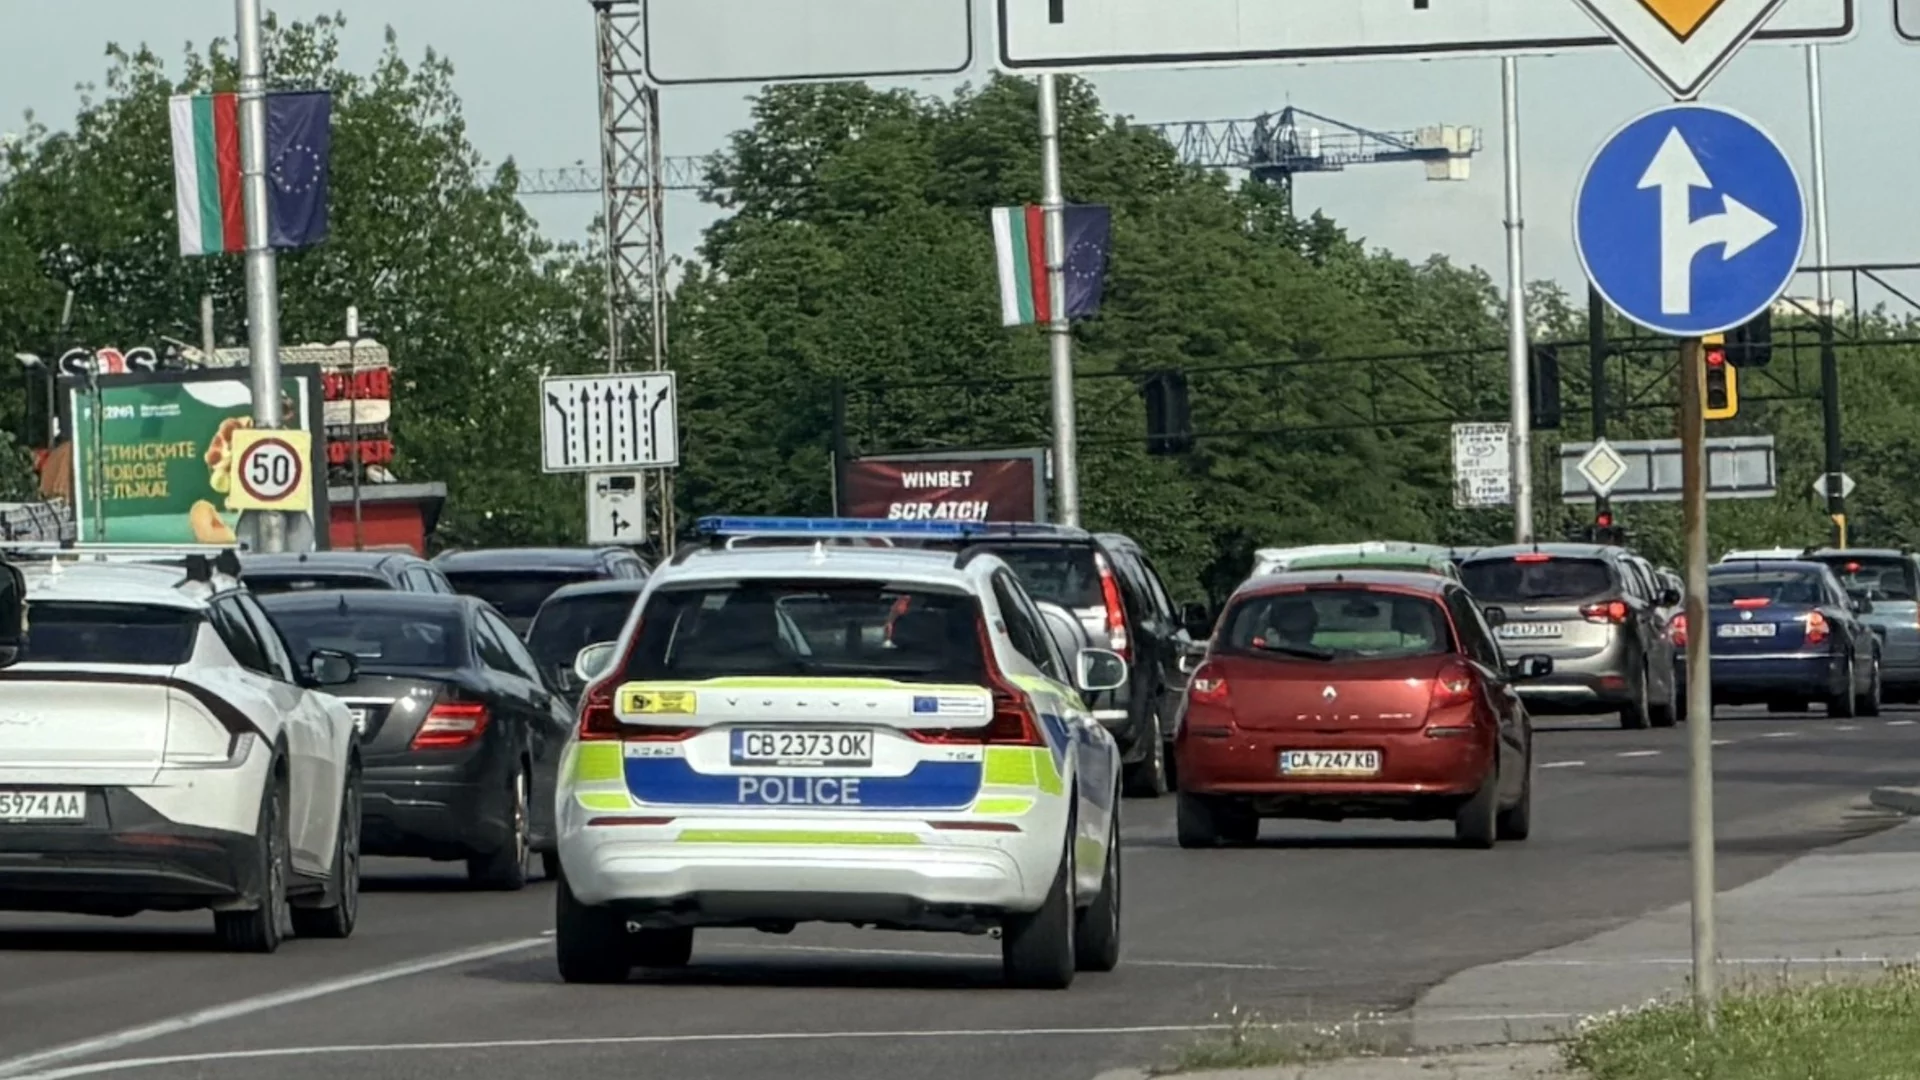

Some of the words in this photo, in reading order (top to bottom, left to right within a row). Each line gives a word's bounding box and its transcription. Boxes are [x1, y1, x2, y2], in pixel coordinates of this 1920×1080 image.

[252, 454, 290, 486] 50
[901, 470, 973, 489] WINBET
[888, 501, 989, 522] SCRATCH
[747, 735, 775, 756] CB
[780, 735, 833, 756] 2373
[838, 735, 867, 756] OK
[1291, 753, 1312, 768] CA
[1315, 753, 1351, 768] 7247
[737, 776, 862, 805] POLICE
[0, 794, 48, 815] 5974
[54, 794, 79, 815] AA
